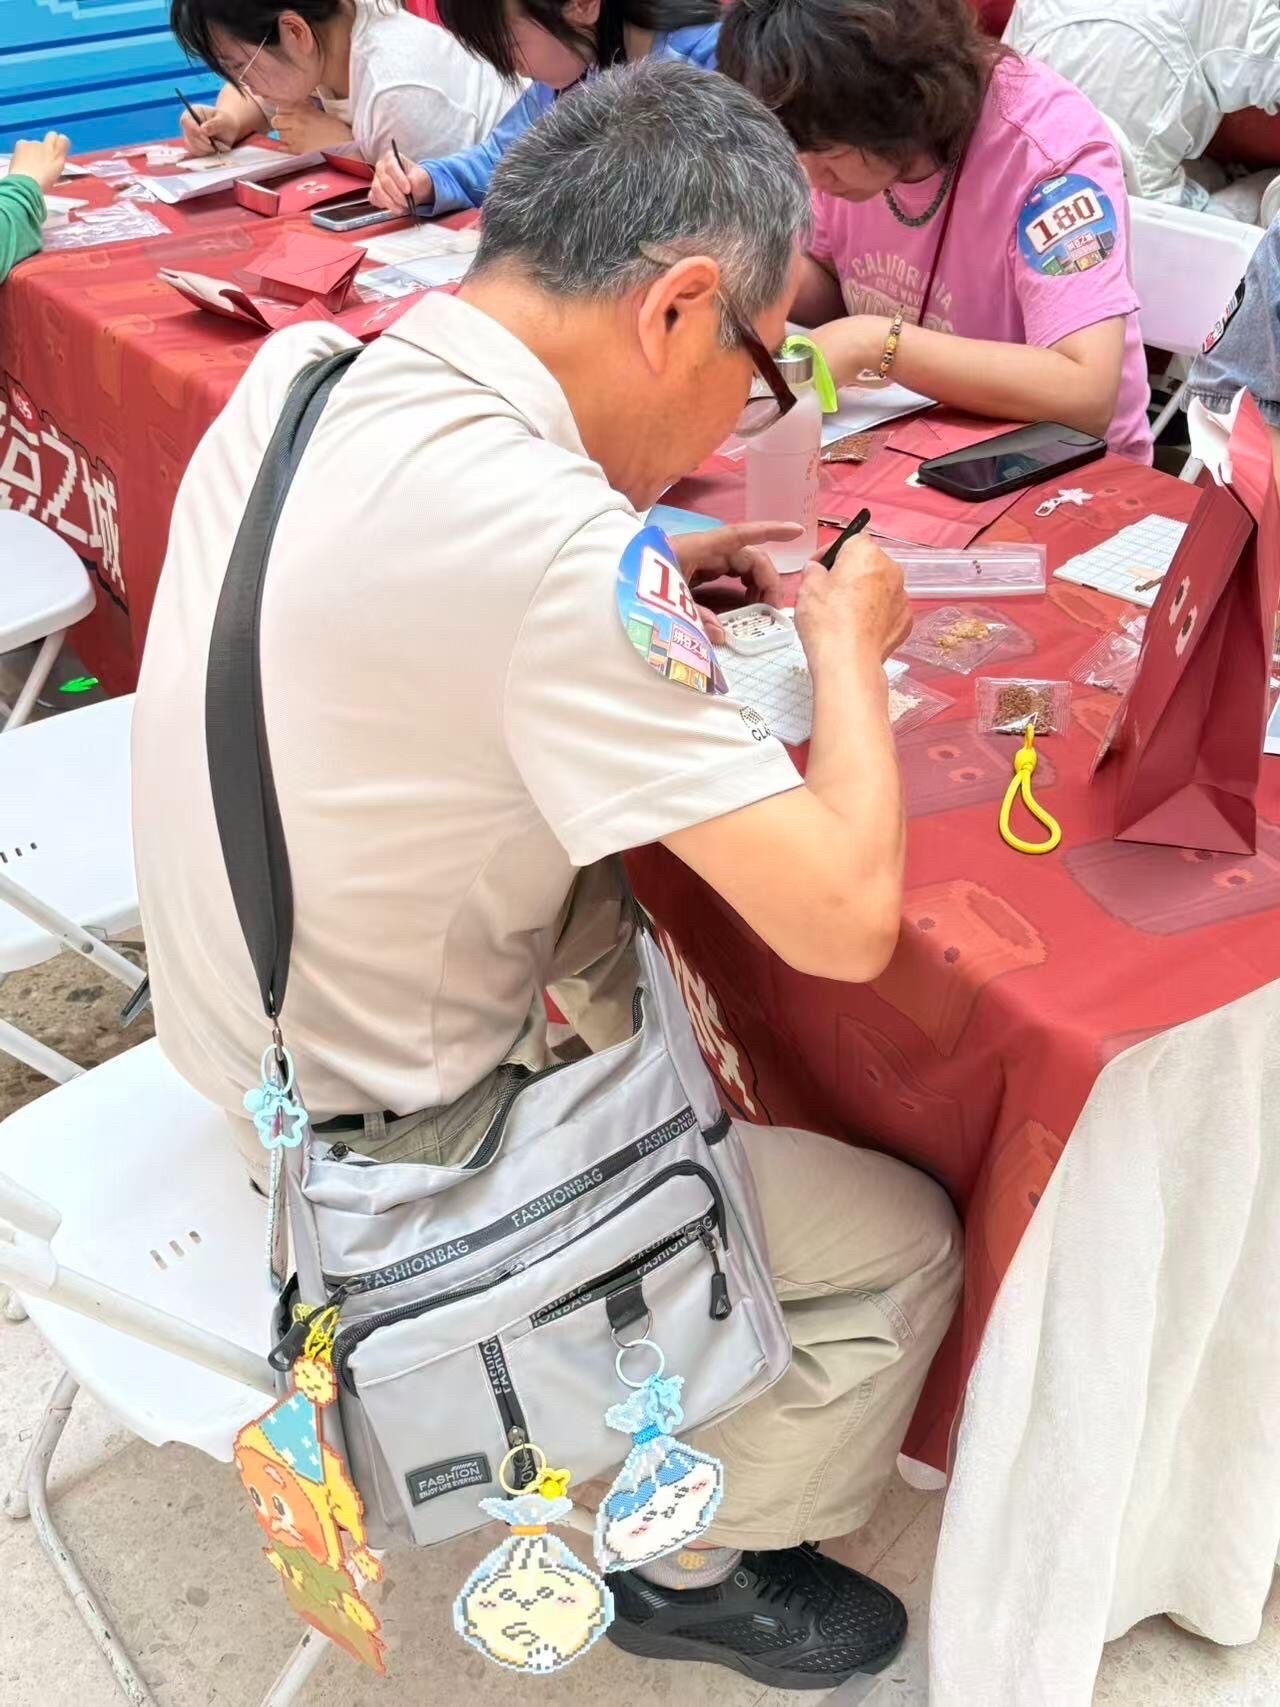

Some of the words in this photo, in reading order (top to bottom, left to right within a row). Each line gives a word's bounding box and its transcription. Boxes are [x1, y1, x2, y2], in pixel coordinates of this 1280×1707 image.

[1032, 195, 1096, 246] 180
[0, 400, 125, 593] 豆之城
[363, 1240, 469, 1289] FASHIONBAG
[511, 1168, 603, 1228] FASHIONBAG
[418, 1466, 480, 1491] FASHION
[419, 1486, 438, 1499] ENJOY
[440, 1481, 452, 1491] LIFE
[452, 1474, 483, 1487] EVERYDAY
